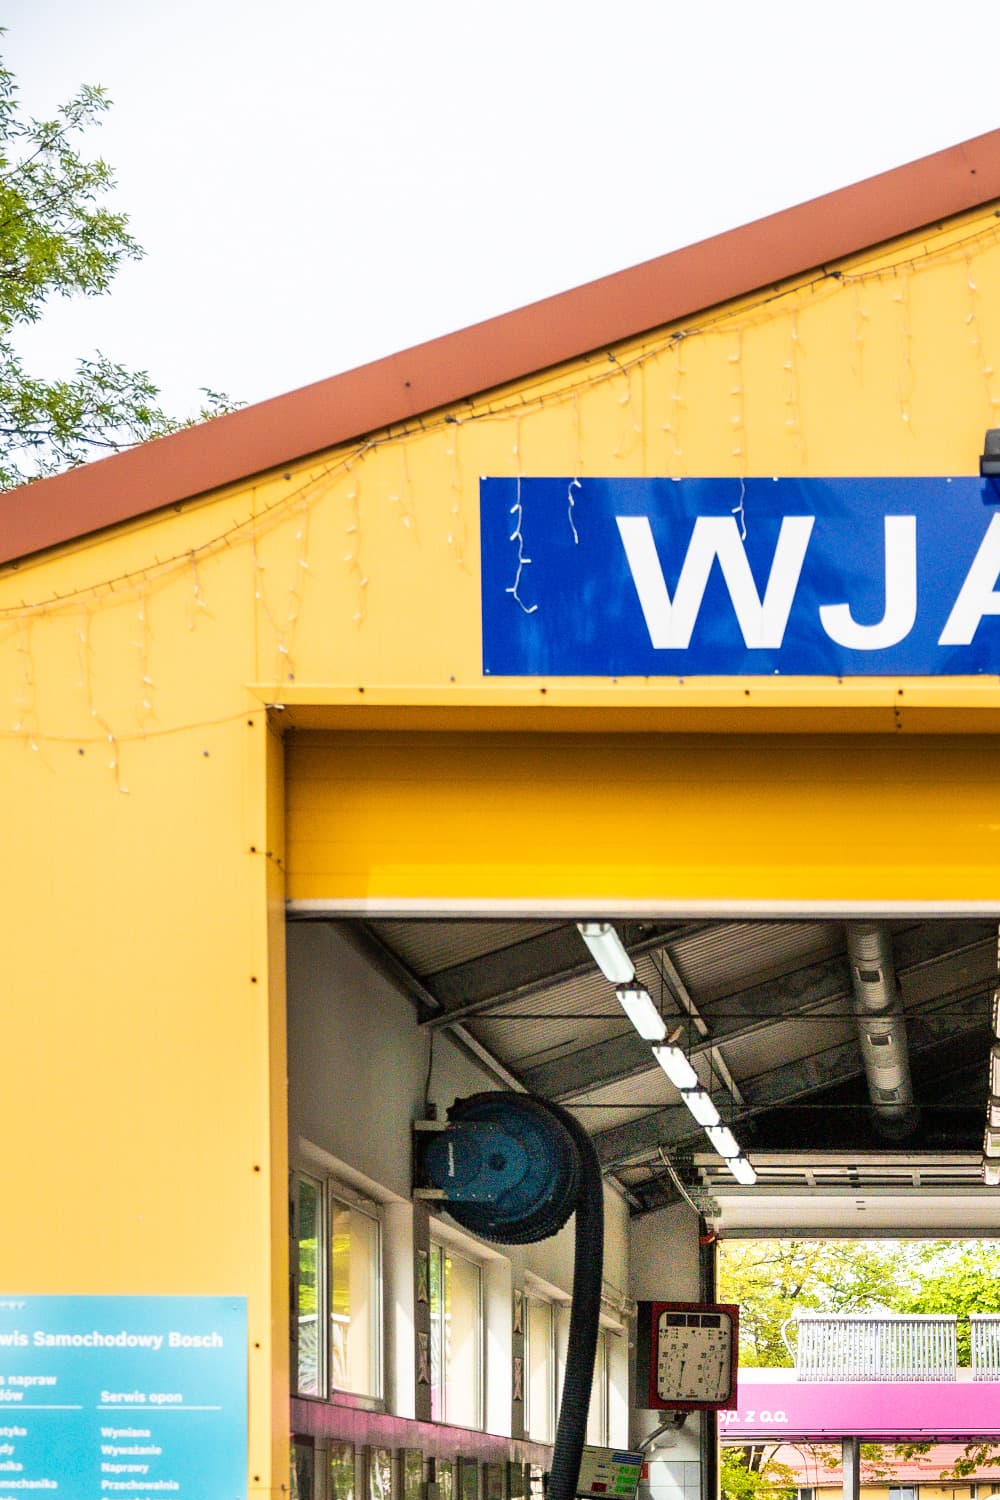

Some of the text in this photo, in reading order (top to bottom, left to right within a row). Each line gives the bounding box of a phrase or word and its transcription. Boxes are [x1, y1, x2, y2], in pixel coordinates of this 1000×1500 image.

[33, 1331, 163, 1350] Samochodowy
[169, 1332, 223, 1348] Bosch
[8, 1375, 57, 1388] napraw
[101, 1391, 183, 1405] Serwis opon
[744, 1410, 756, 1422] z
[101, 1427, 151, 1439] Wymiana
[101, 1463, 149, 1475] Naprawy
